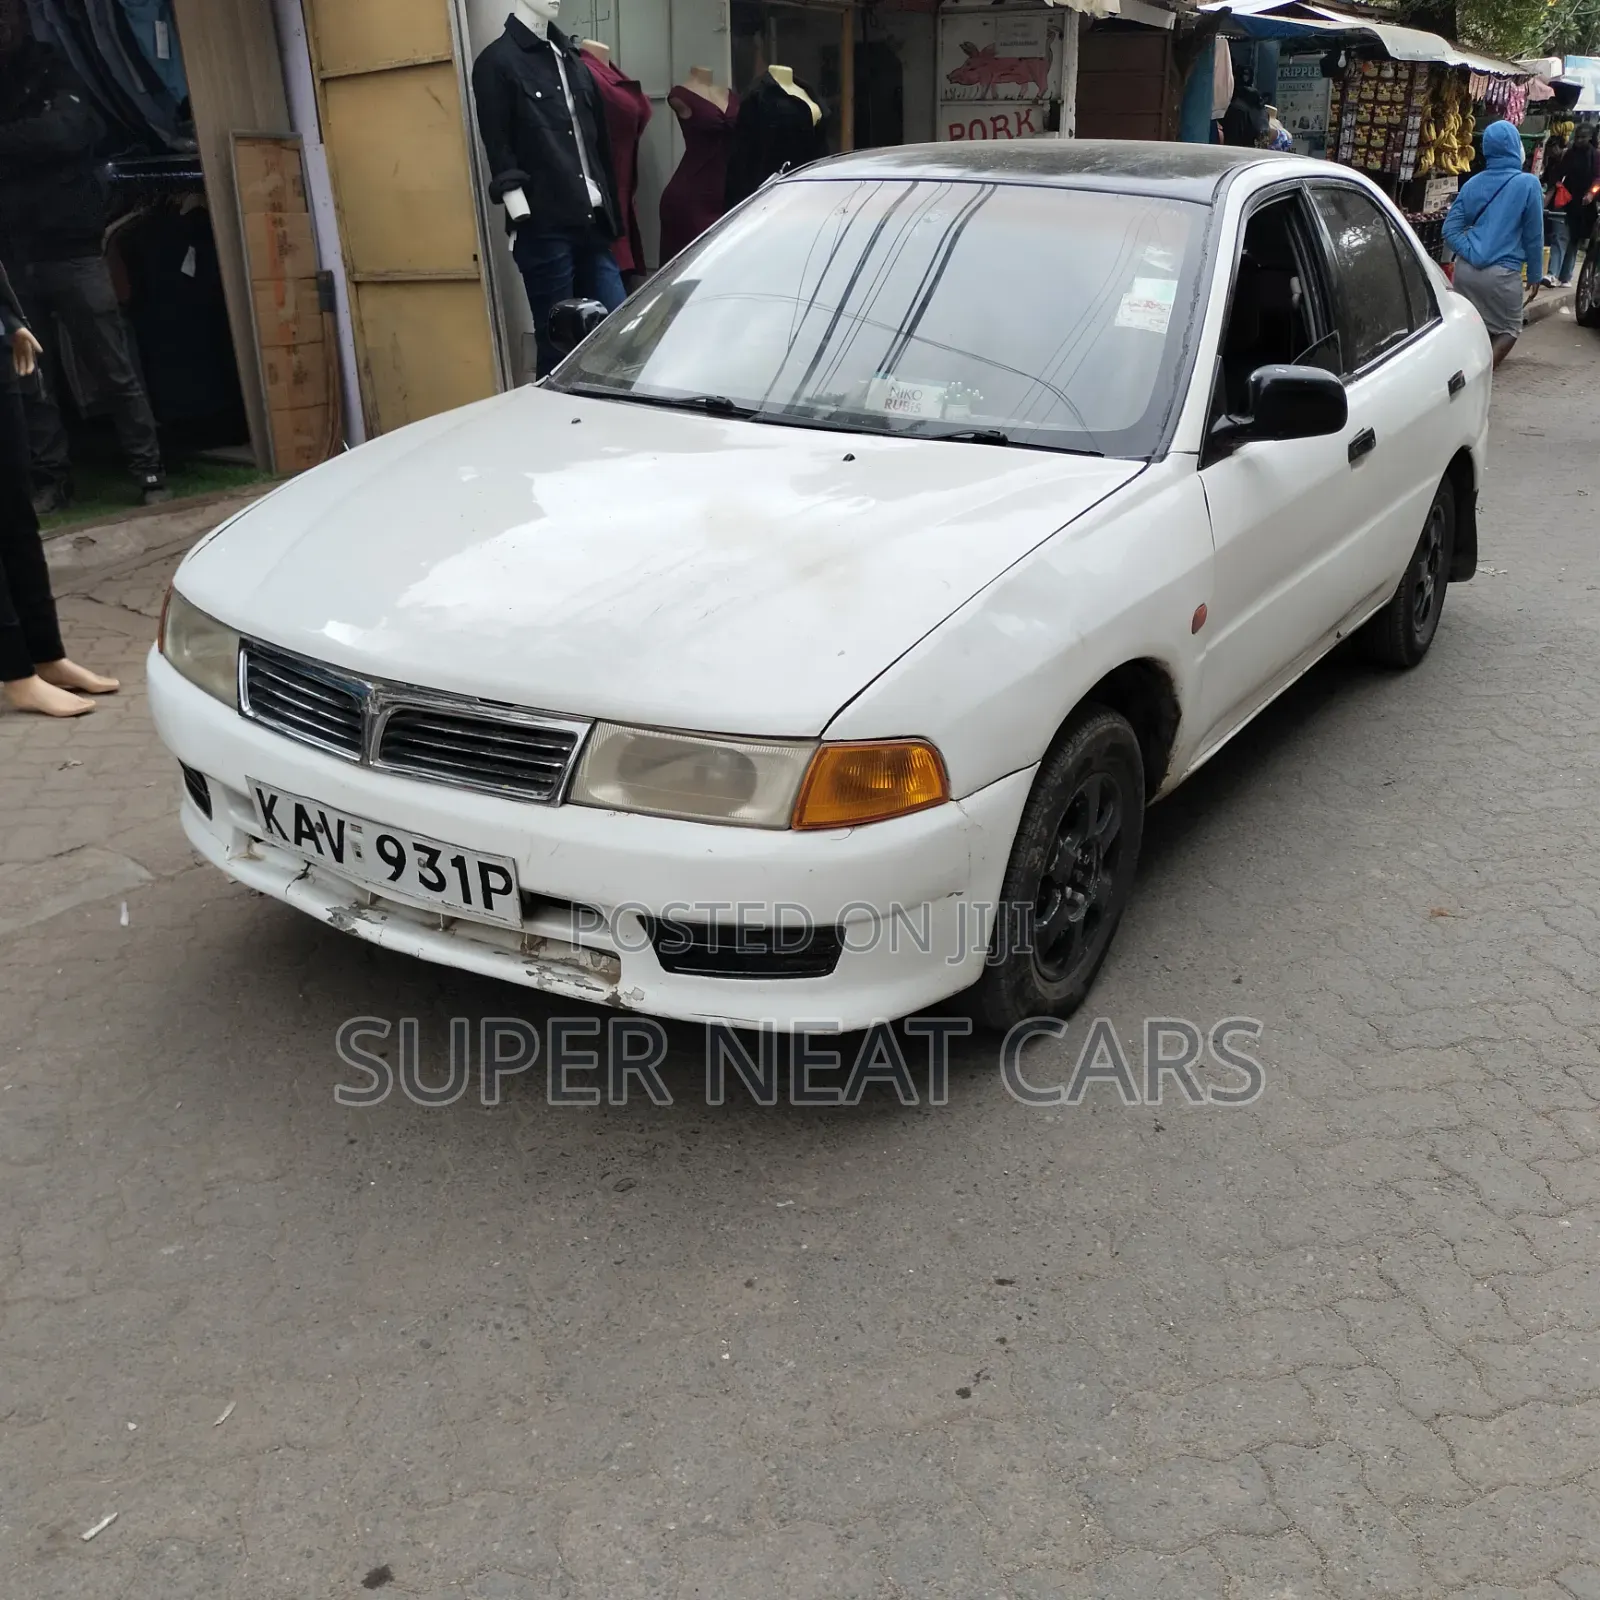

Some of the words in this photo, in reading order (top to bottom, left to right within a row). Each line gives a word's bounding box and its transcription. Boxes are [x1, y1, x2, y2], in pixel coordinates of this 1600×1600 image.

[948, 108, 1035, 141] PORK
[890, 386, 922, 400] NIKO
[255, 788, 345, 863] KAV
[375, 834, 513, 911] 931P
